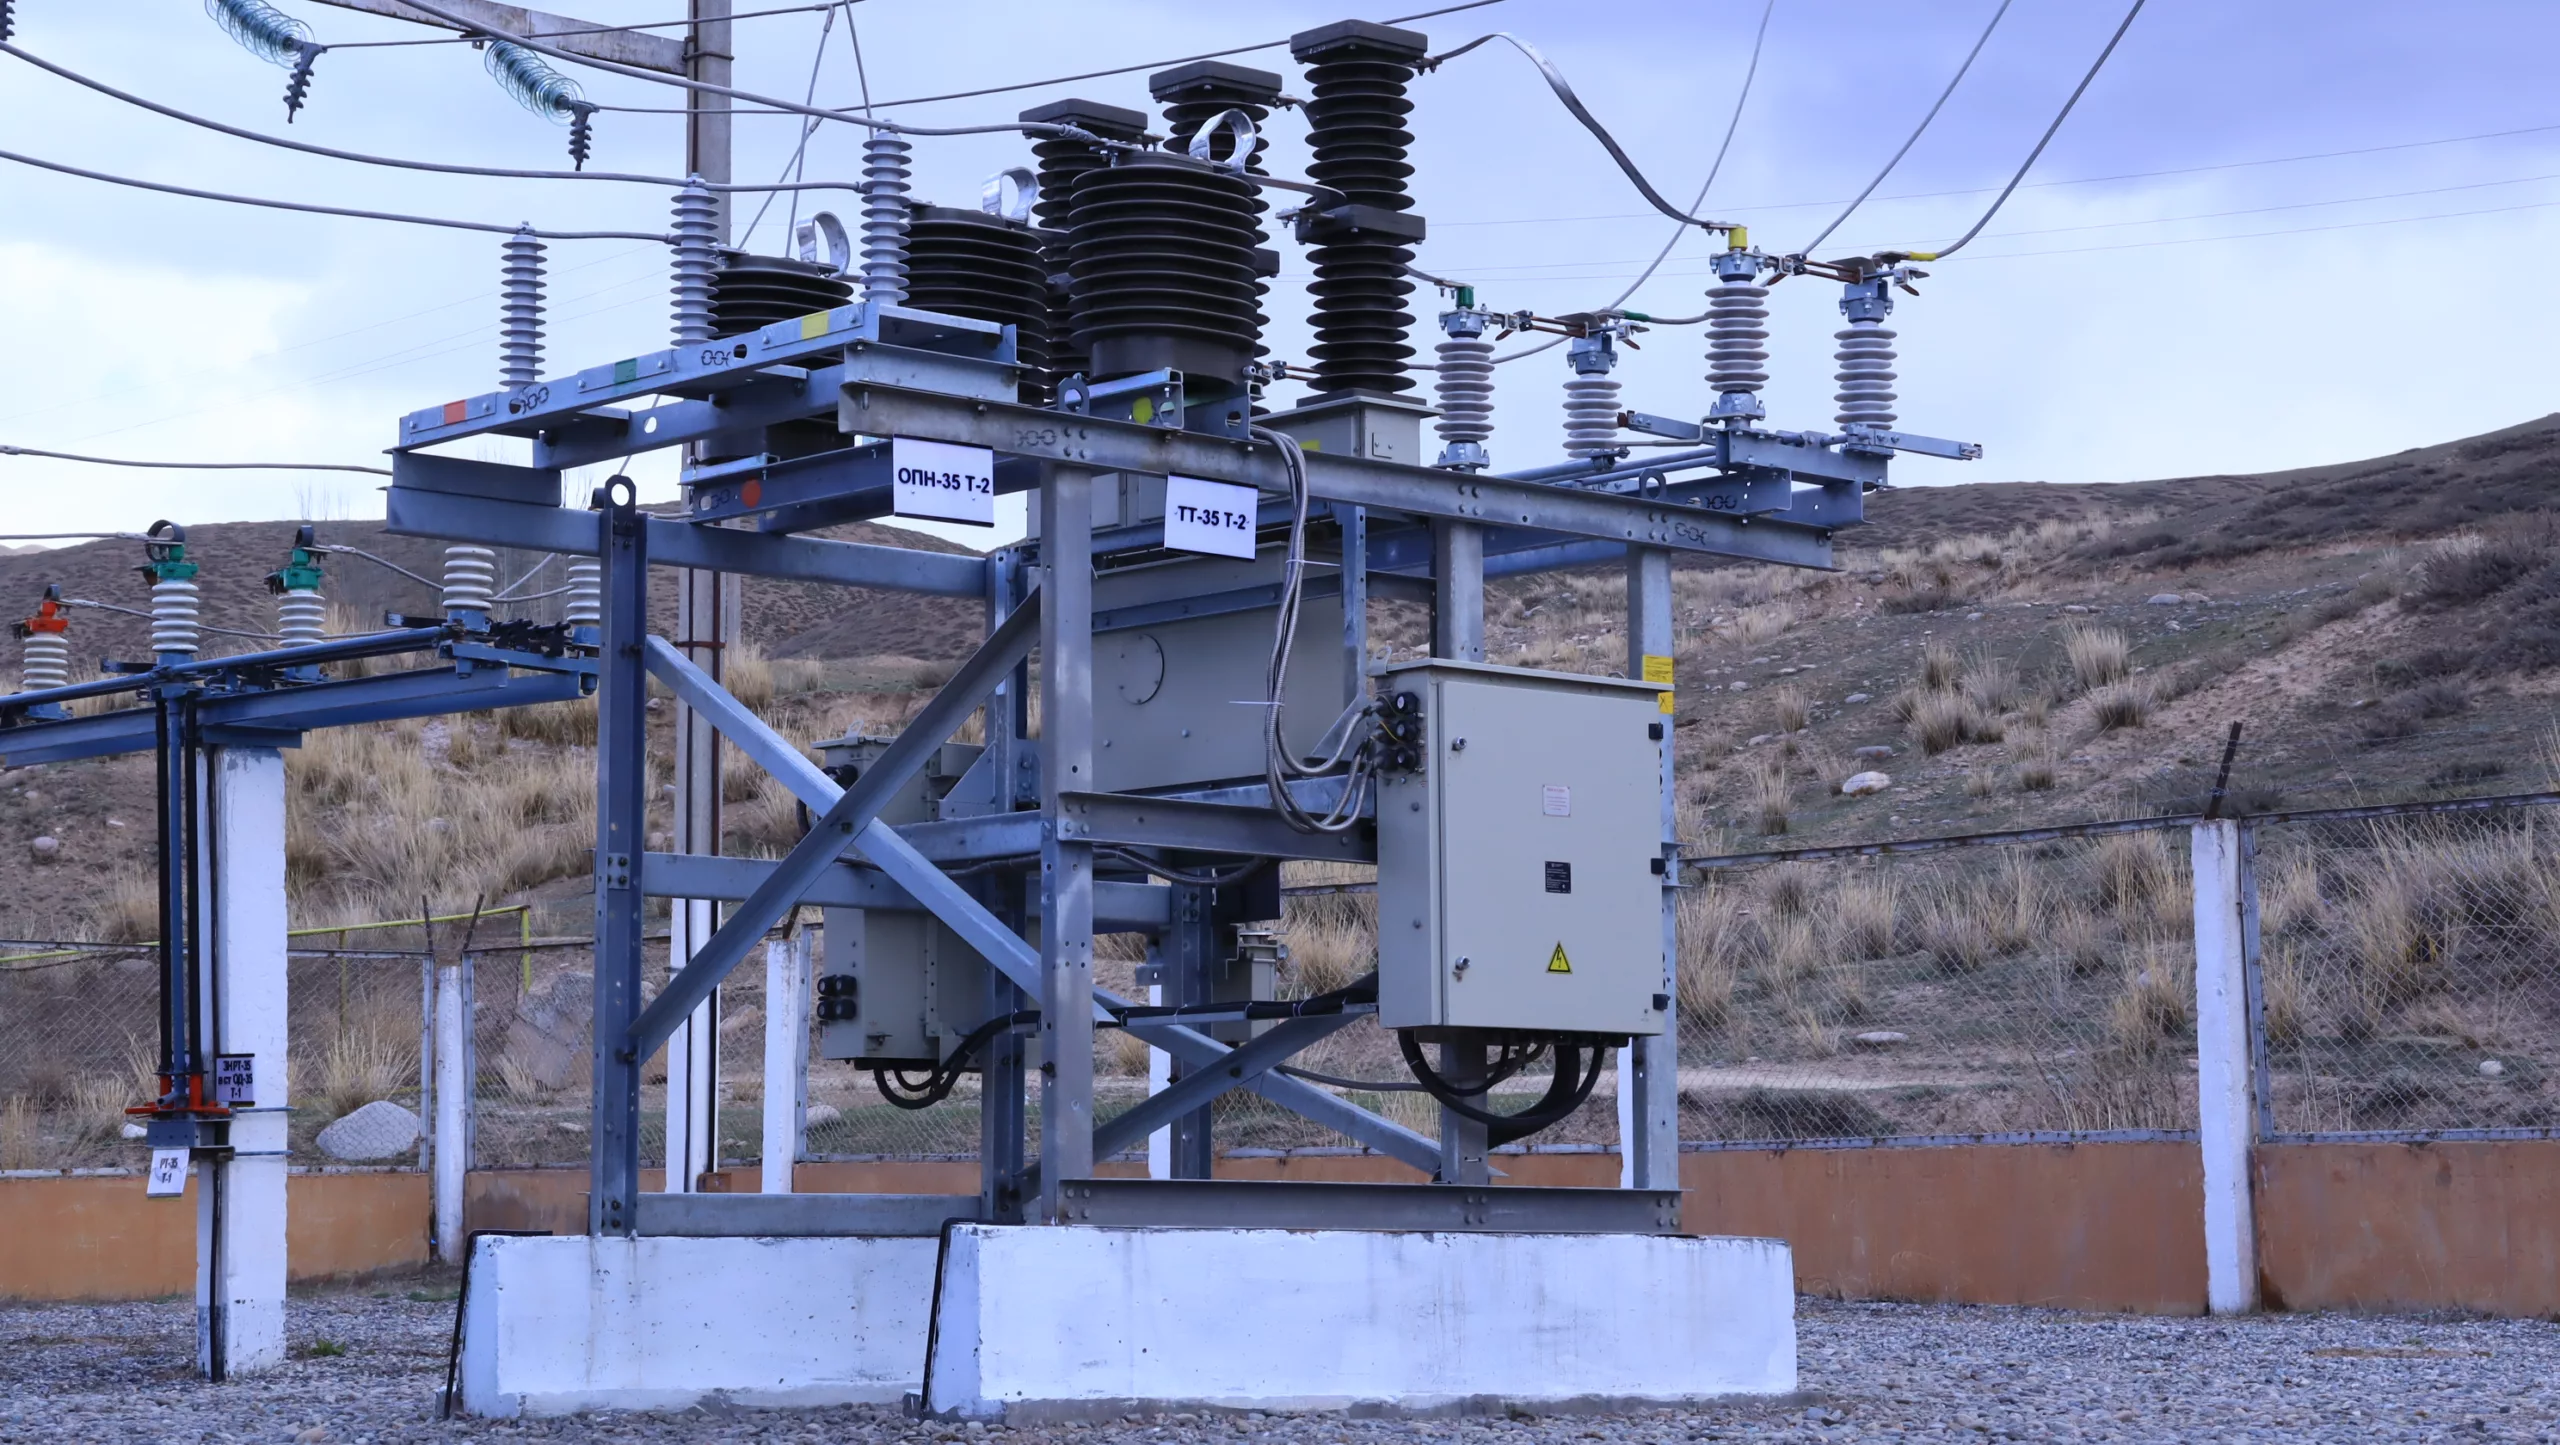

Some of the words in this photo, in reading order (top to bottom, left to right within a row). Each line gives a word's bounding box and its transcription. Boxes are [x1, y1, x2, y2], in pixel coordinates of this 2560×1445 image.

[898, 467, 961, 490] ОПН-35
[965, 474, 990, 493] Т-2
[1178, 505, 1220, 526] ТТ-35
[1224, 511, 1246, 530] Т-2
[230, 1088, 242, 1098] Т-1
